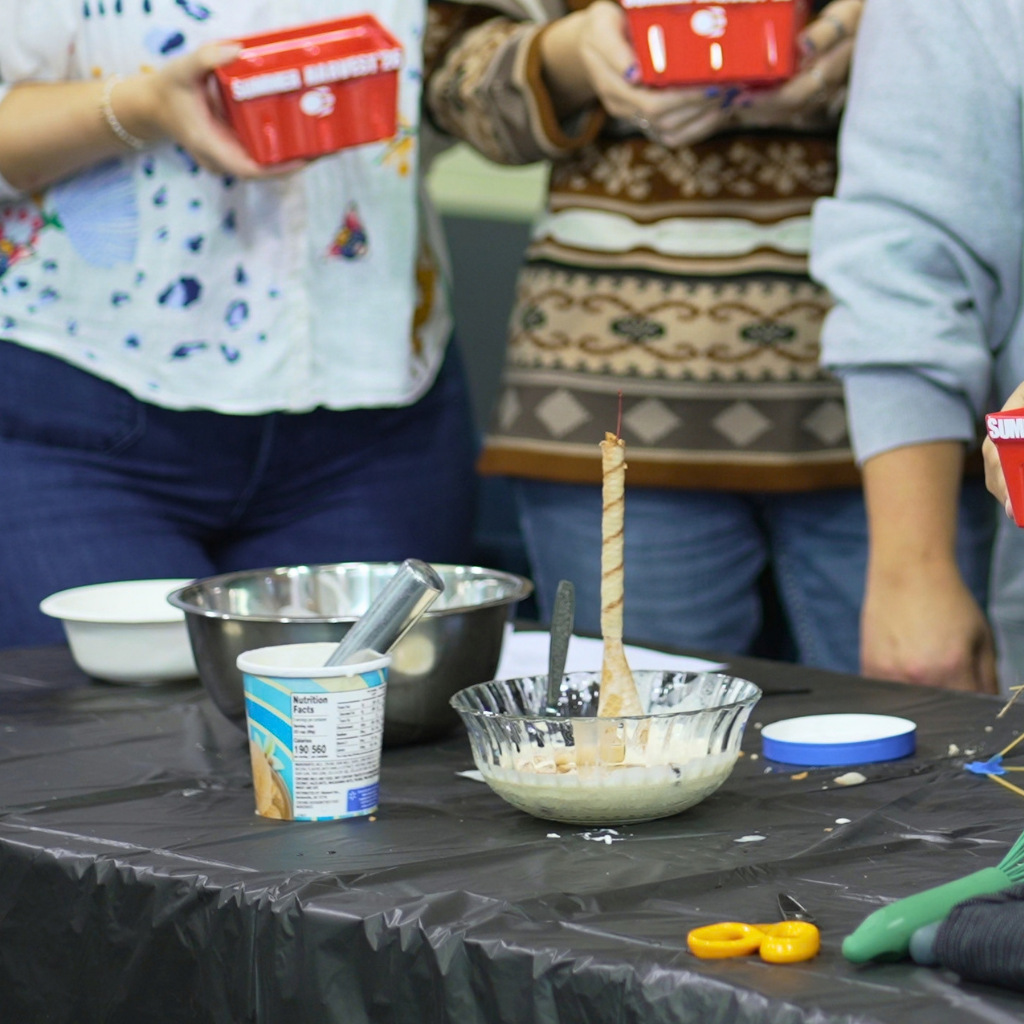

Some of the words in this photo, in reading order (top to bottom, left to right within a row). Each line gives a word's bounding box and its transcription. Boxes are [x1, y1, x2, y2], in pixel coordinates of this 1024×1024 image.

[293, 695, 328, 704] Nutrition
[293, 705, 315, 714] Facts
[294, 744, 309, 754] 190
